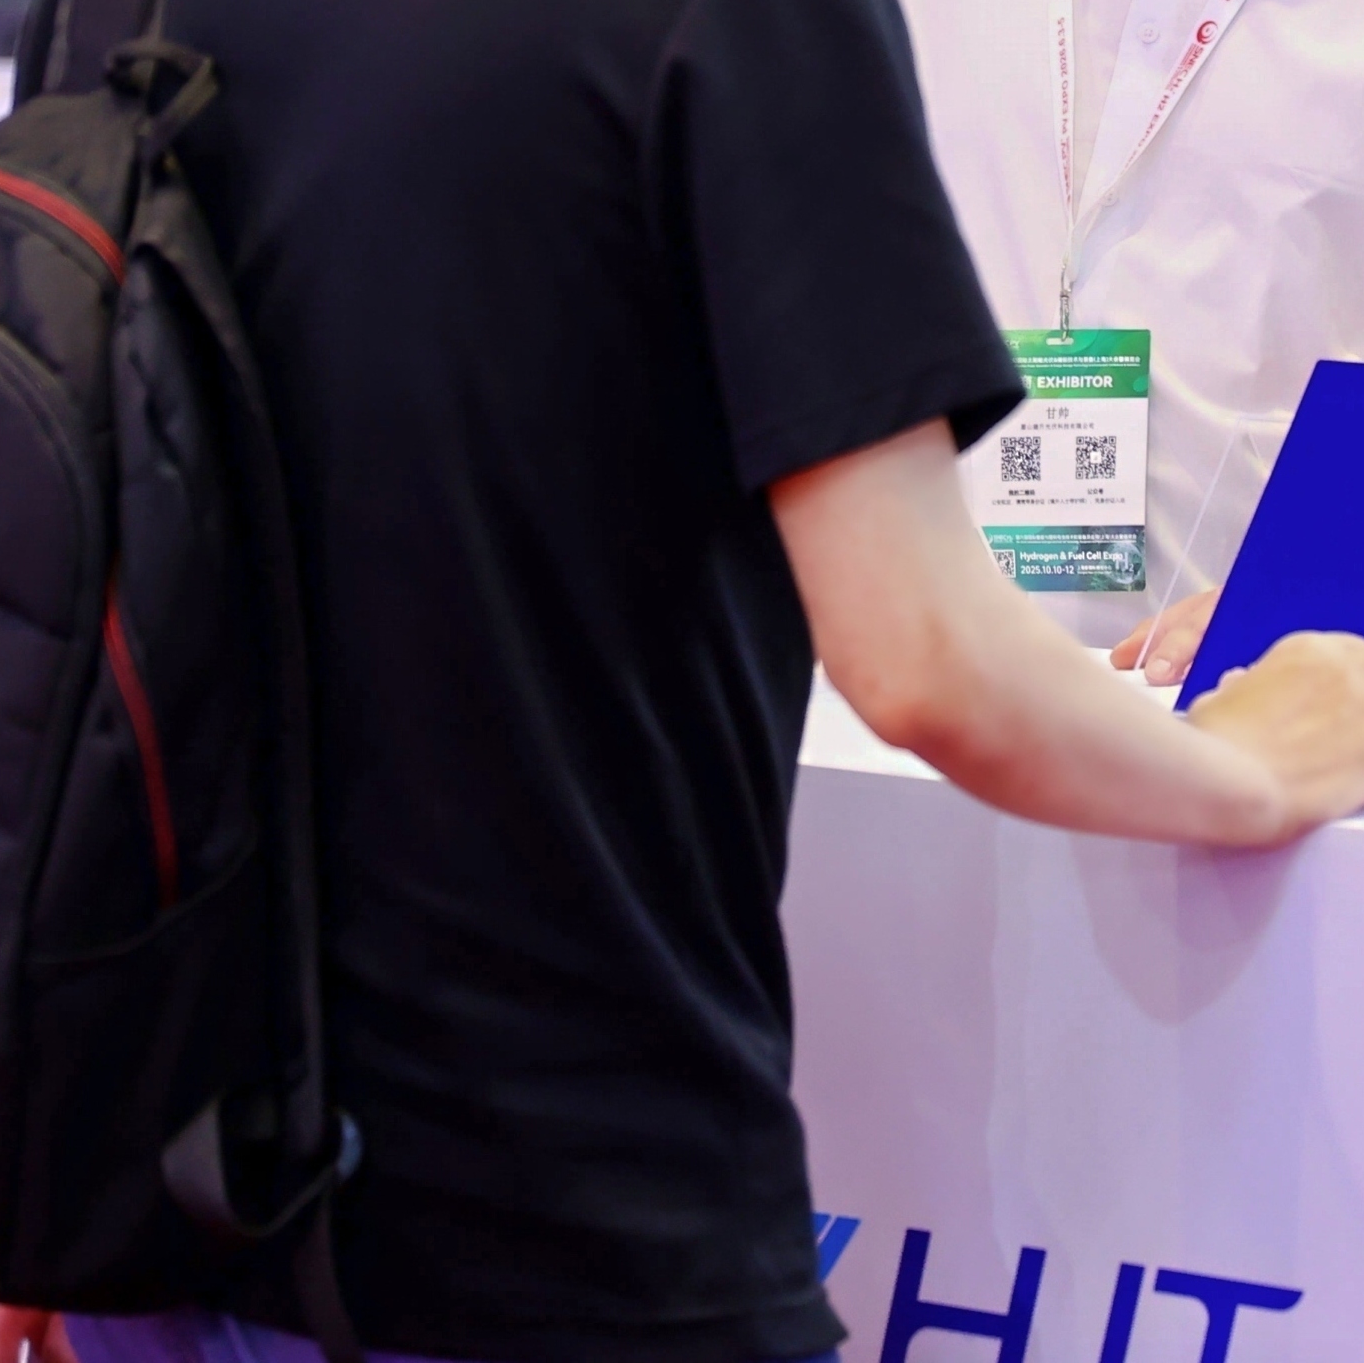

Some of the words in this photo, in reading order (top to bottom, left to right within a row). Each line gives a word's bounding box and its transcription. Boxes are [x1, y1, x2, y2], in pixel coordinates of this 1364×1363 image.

[1061, 80, 1069, 115] EXPO
[1036, 374, 1113, 389] EXHIBITOR
[1019, 551, 1059, 563] Hydrogen
[1059, 552, 1067, 560] &
[1068, 551, 1085, 560] Fuel
[1086, 551, 1101, 560] Cell
[1103, 551, 1123, 562] Expo
[1020, 565, 1075, 575] 2025.10.10-12
